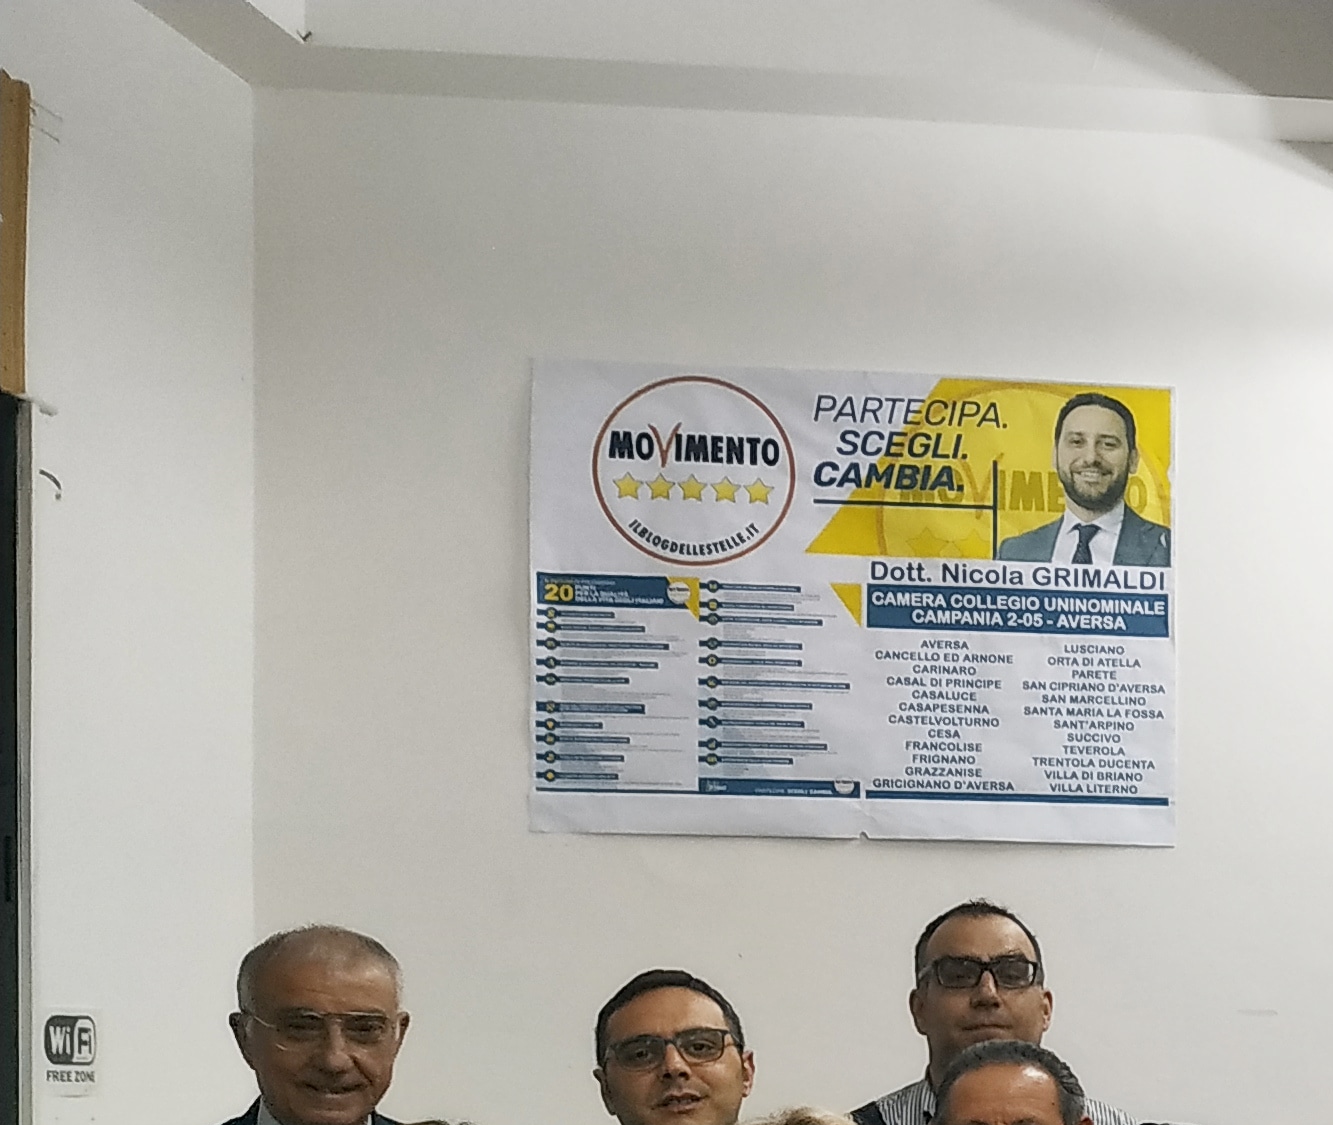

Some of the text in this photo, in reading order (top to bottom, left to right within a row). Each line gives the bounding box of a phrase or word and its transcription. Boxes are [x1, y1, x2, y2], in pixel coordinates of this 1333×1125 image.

[813, 394, 1008, 429] PARTECIPA.
[608, 422, 780, 468] MOVIMENTO
[836, 429, 968, 460] SCEGLI.
[813, 461, 964, 493] CAMBIA.
[628, 519, 760, 556] ILBLOGDELLESTELLE.IT
[870, 561, 1165, 591] Dott. Nicola GRIMALDI
[544, 583, 574, 602] 20
[871, 591, 1165, 615] CAMERA COLLEGIO UNINOMINALE
[911, 610, 1004, 627] CAMPANIA
[1006, 612, 1044, 628] 2-05
[1056, 614, 1127, 631] AVERSA
[920, 640, 970, 650] AVERSA
[1064, 644, 1126, 655] LUSCIANO
[875, 650, 1014, 665] CANCELLO ED ARNONE
[1047, 656, 1142, 668] ORTA DI ATELLA
[912, 664, 977, 676] CARINARO
[1071, 669, 1117, 680] PARETE
[886, 676, 1002, 690] CASAL DI PRINCIPE
[1022, 681, 1166, 694] SAN CIPRIANO D'AVERSA
[912, 690, 977, 702] CASALUCE
[1041, 694, 1147, 706] SAN MARCELLINO
[899, 702, 990, 715] CASAPESENNA
[1023, 706, 1165, 719] SANTA MARIA LA FOSSA
[888, 715, 1000, 728] CASTELVOLTURNO
[1053, 720, 1135, 731] SANT'ARPINO
[928, 729, 961, 739] CESA
[1067, 732, 1121, 743] SUCCIVO
[905, 741, 983, 753] FRANCOLISE
[1062, 745, 1126, 756] TEVEROLA
[912, 754, 976, 766] FRIGNANO
[1032, 757, 1156, 770] TRENTOLA DUCENTA
[905, 766, 983, 778] GRAZZANISE
[1044, 770, 1143, 782] VILLA DI BRIANO
[872, 778, 1015, 791] GRICIGNANO D'AVERSA
[1049, 783, 1138, 794] VILLA LITERNO
[46, 1069, 96, 1083] FREE ZONE
